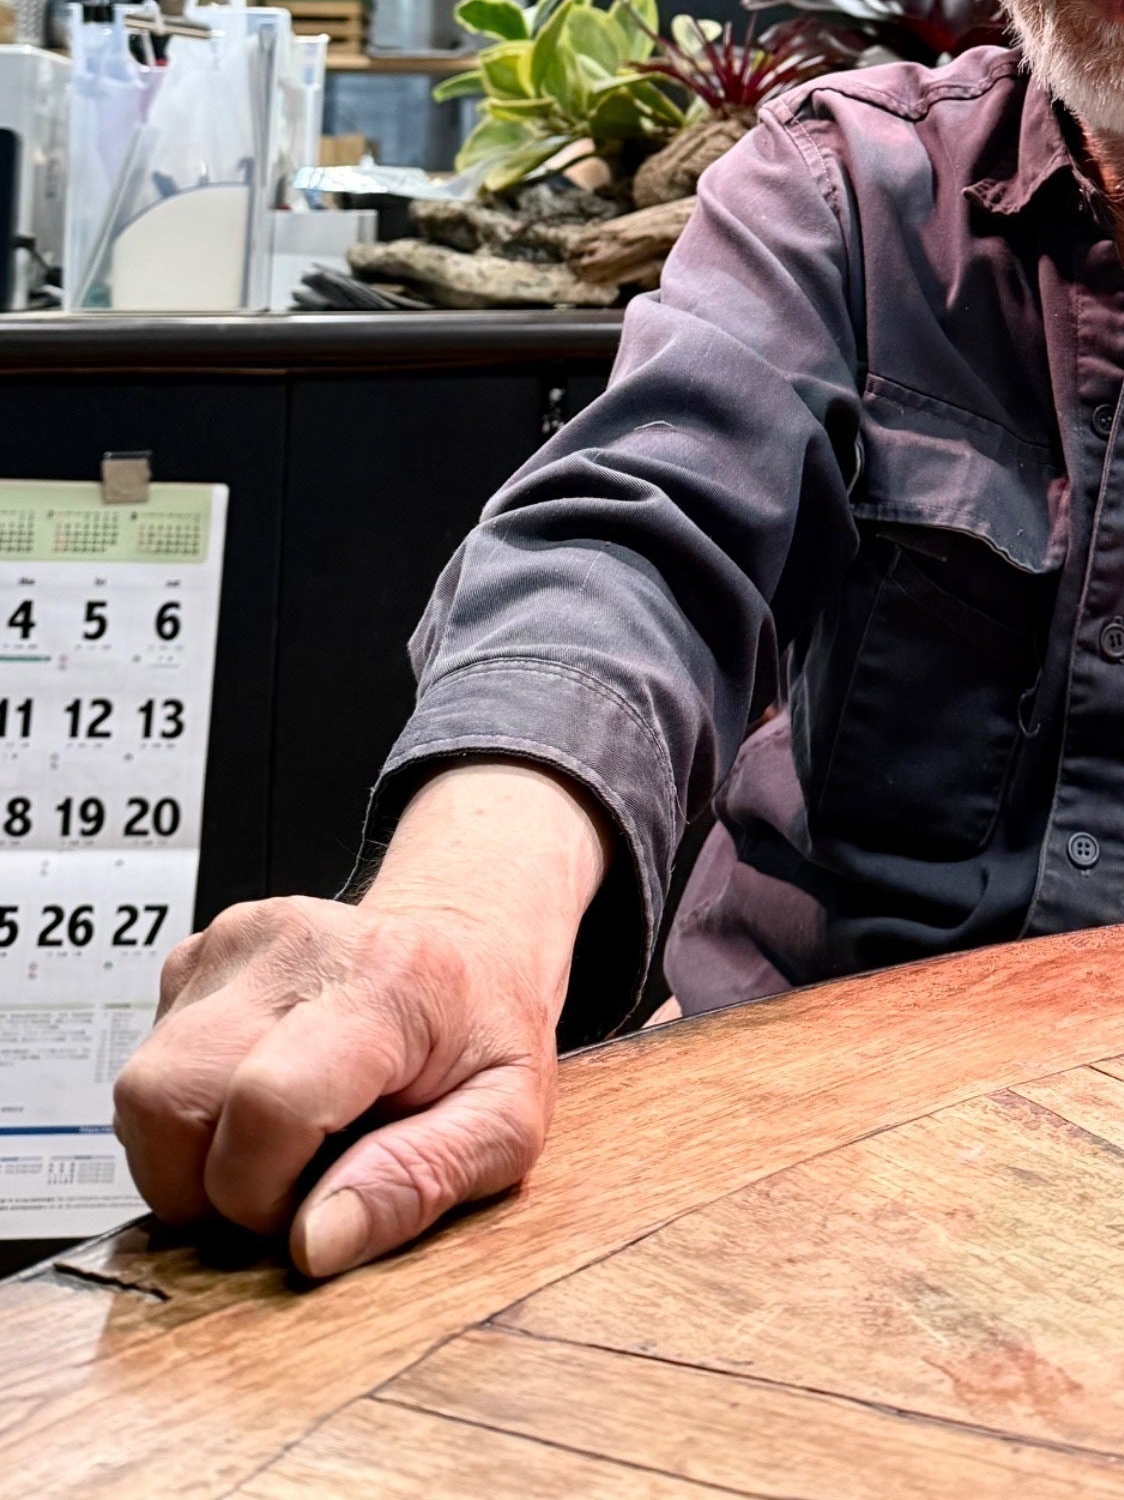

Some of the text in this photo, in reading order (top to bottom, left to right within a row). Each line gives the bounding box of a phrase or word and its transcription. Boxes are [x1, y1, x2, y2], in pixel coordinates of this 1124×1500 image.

[7, 599, 181, 641] 4 5 6
[65, 698, 113, 739] 12
[138, 698, 185, 740] 13
[56, 797, 105, 838] 19
[123, 797, 181, 838] 20
[37, 904, 94, 948] 26
[112, 904, 168, 947] 27
